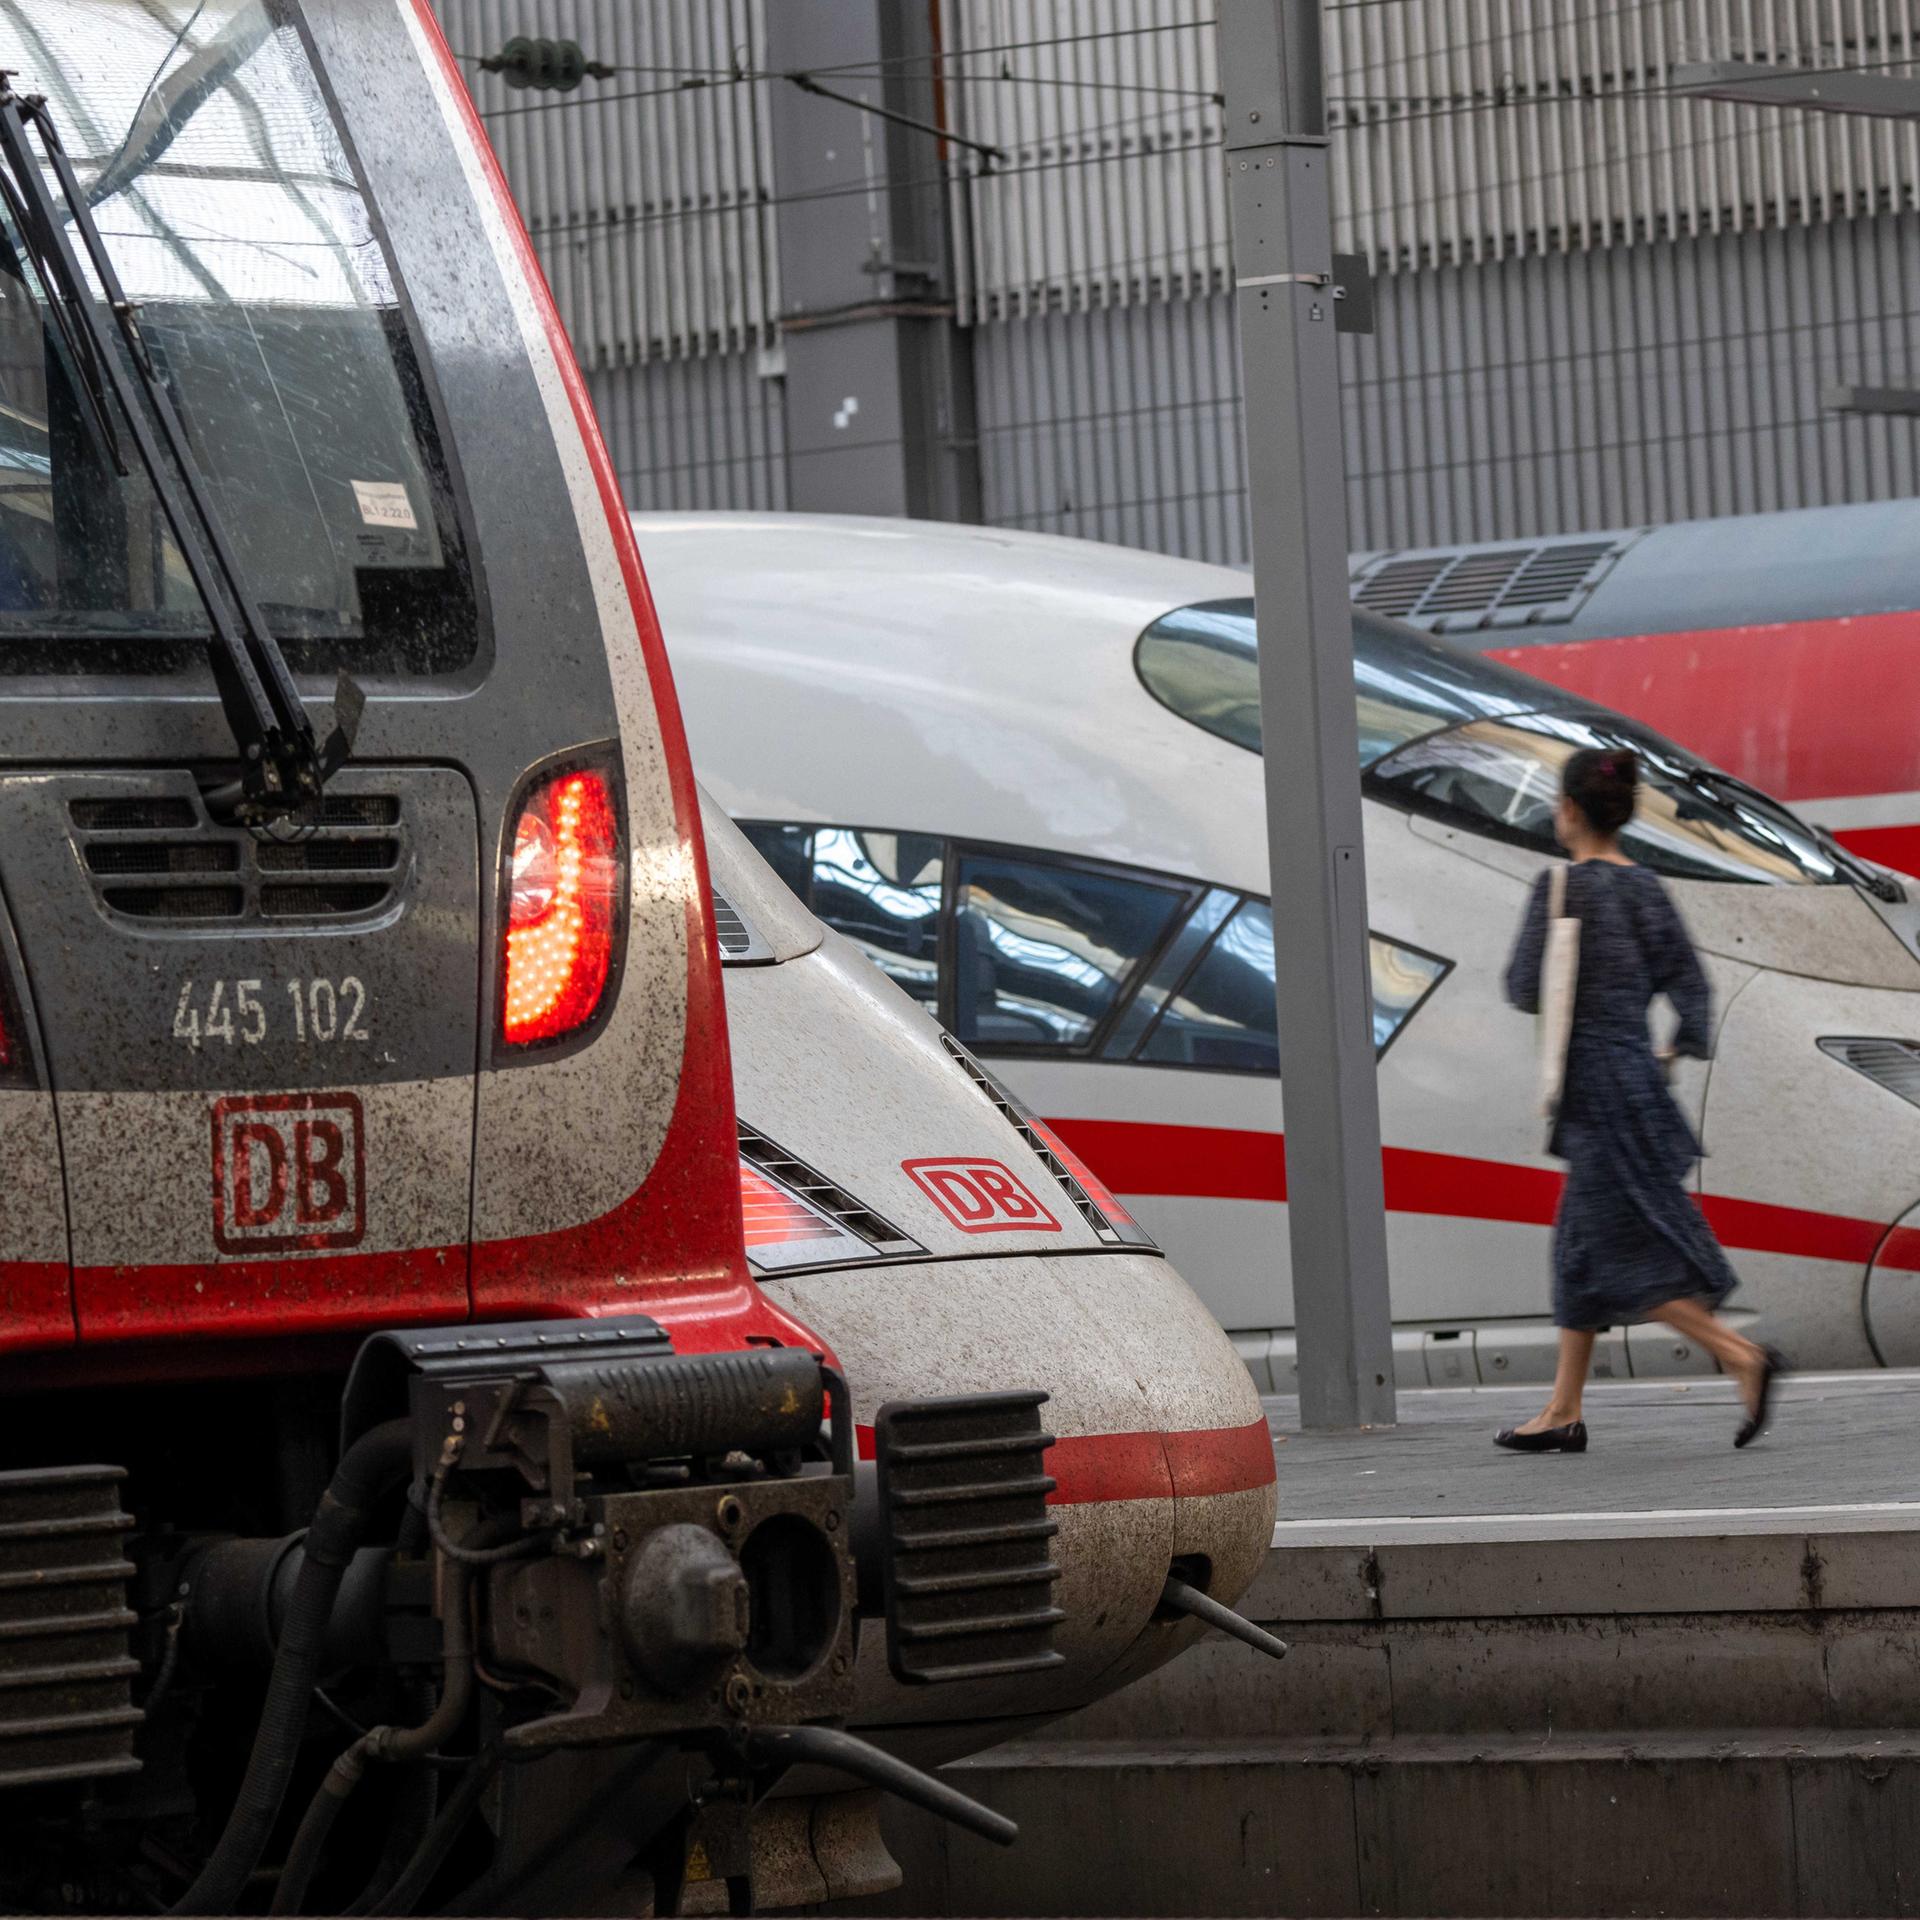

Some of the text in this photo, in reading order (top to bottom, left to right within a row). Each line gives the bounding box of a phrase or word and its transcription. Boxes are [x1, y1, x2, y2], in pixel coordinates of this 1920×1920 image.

[173, 976, 369, 1047] 445 102
[233, 1120, 349, 1227] DB
[922, 1169, 1037, 1220] DB
